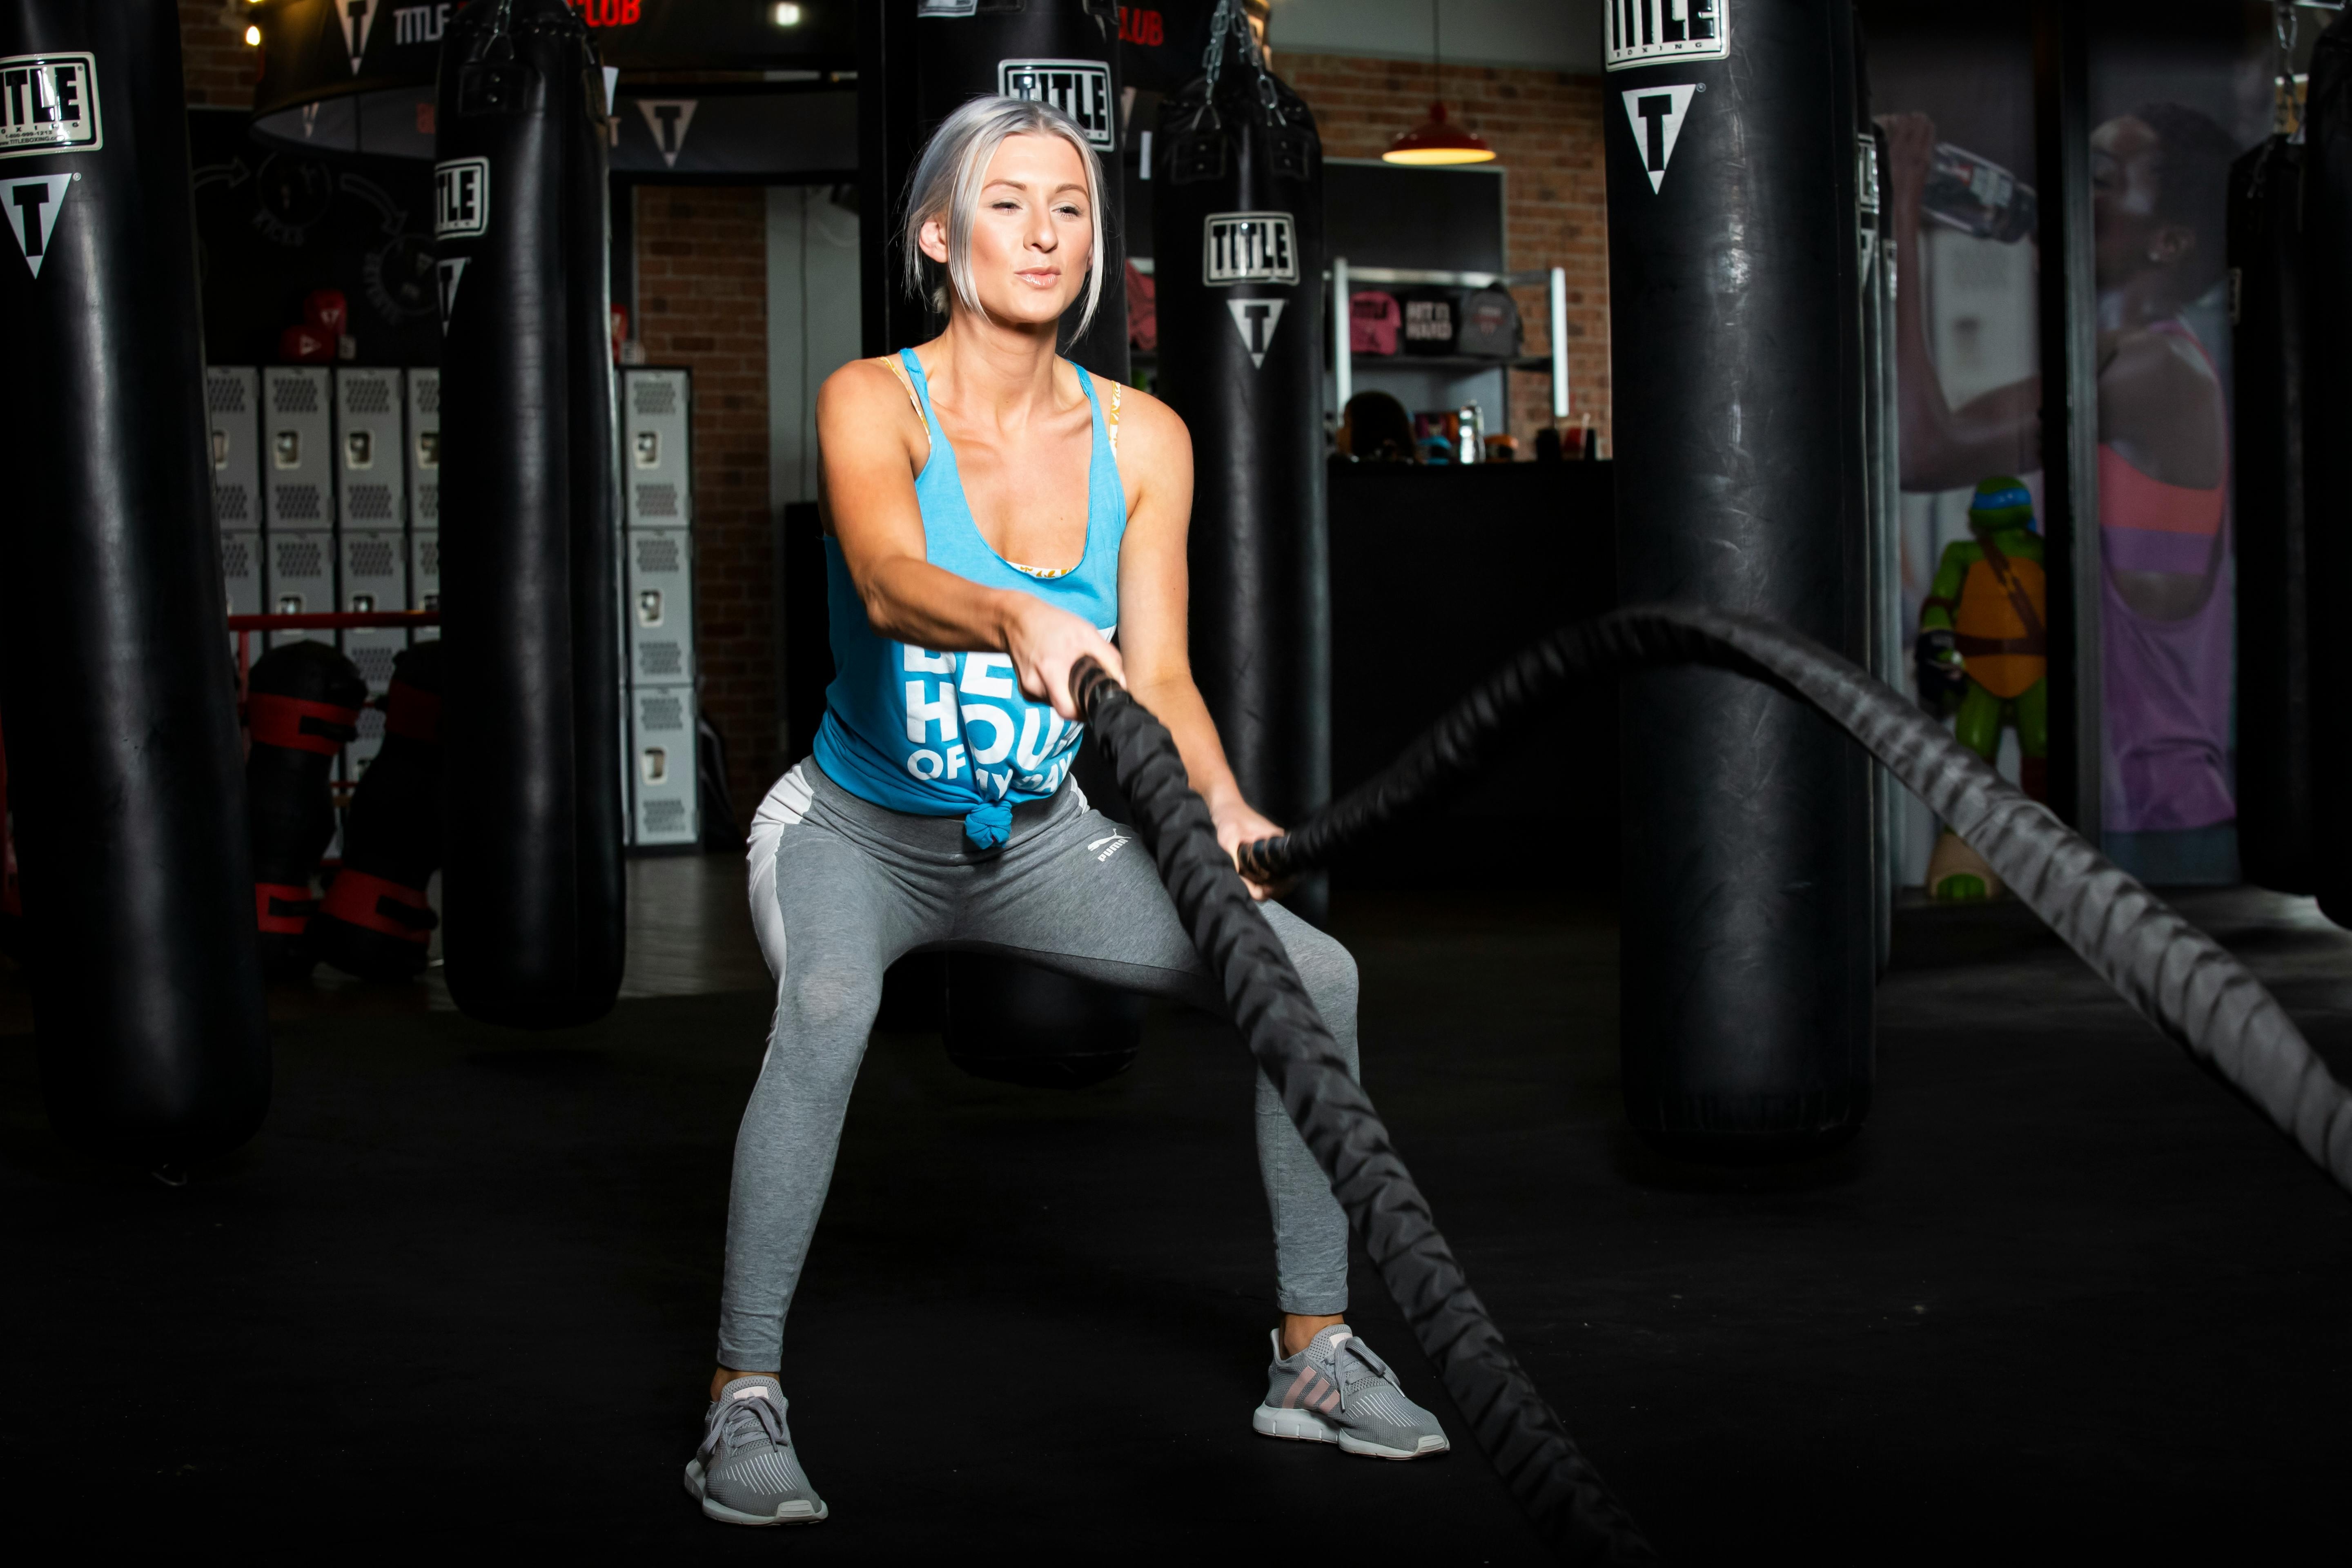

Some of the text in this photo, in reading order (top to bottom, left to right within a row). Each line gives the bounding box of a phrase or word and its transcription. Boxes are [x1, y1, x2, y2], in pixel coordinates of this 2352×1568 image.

[1213, 222, 1288, 270] TITLE
[907, 742, 966, 781] OF
[1097, 838, 1129, 862] PUMA
